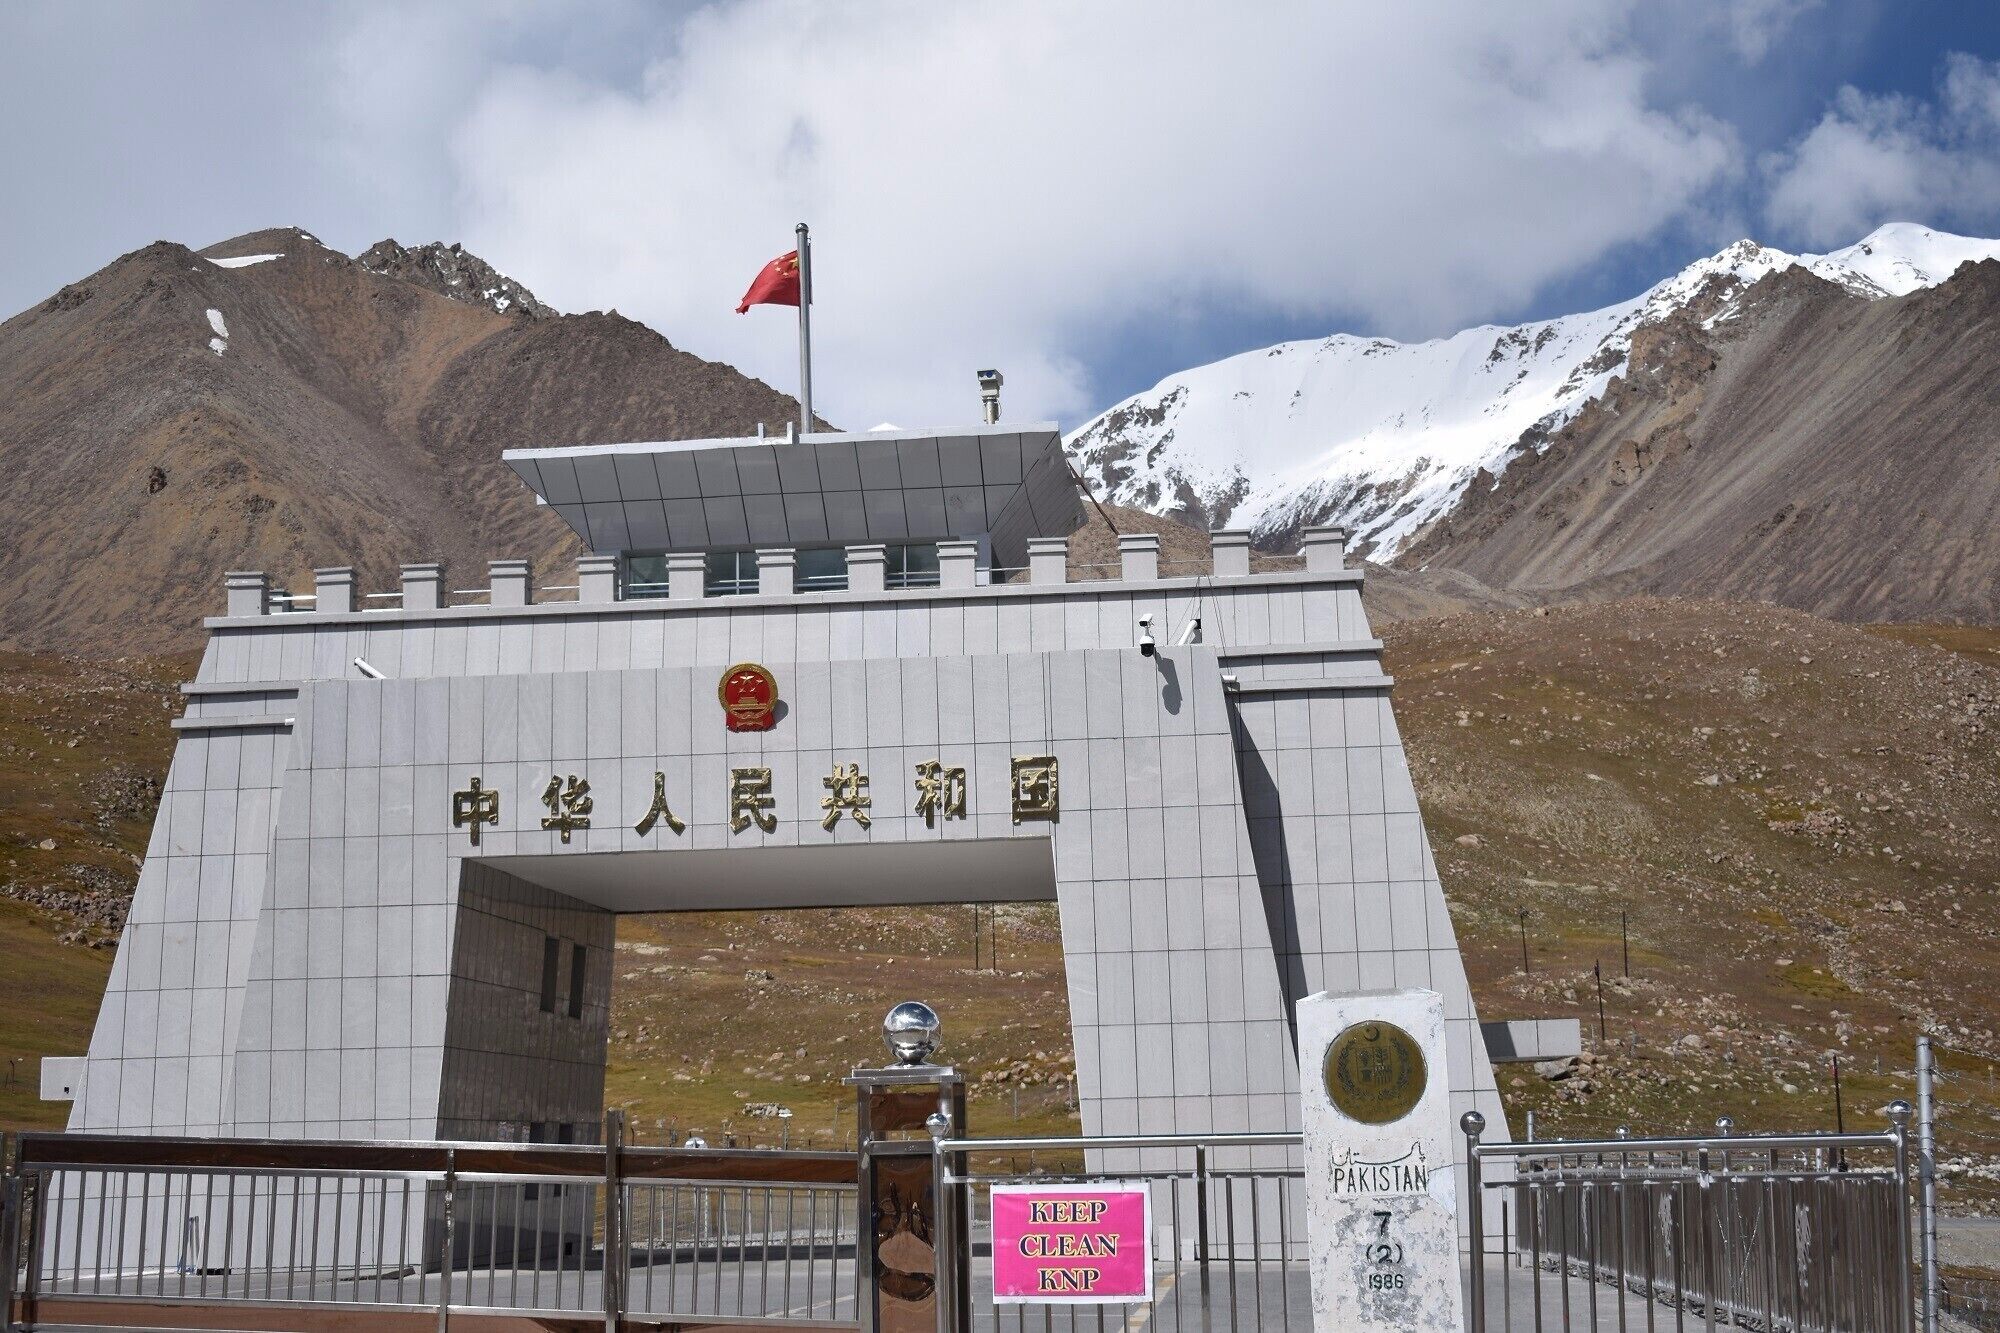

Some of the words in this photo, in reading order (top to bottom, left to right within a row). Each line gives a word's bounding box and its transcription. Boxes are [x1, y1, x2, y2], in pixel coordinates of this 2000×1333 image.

[453, 755, 1059, 846] 中华人民共和国
[1334, 1165, 1427, 1194] PAKISTAN
[1029, 1200, 1107, 1224] KEEP
[1373, 1211, 1392, 1236] 7
[1019, 1233, 1120, 1258] CLEAN
[1366, 1243, 1403, 1265] (2)
[1037, 1267, 1101, 1292] KNP
[1368, 1273, 1404, 1290] 1986
